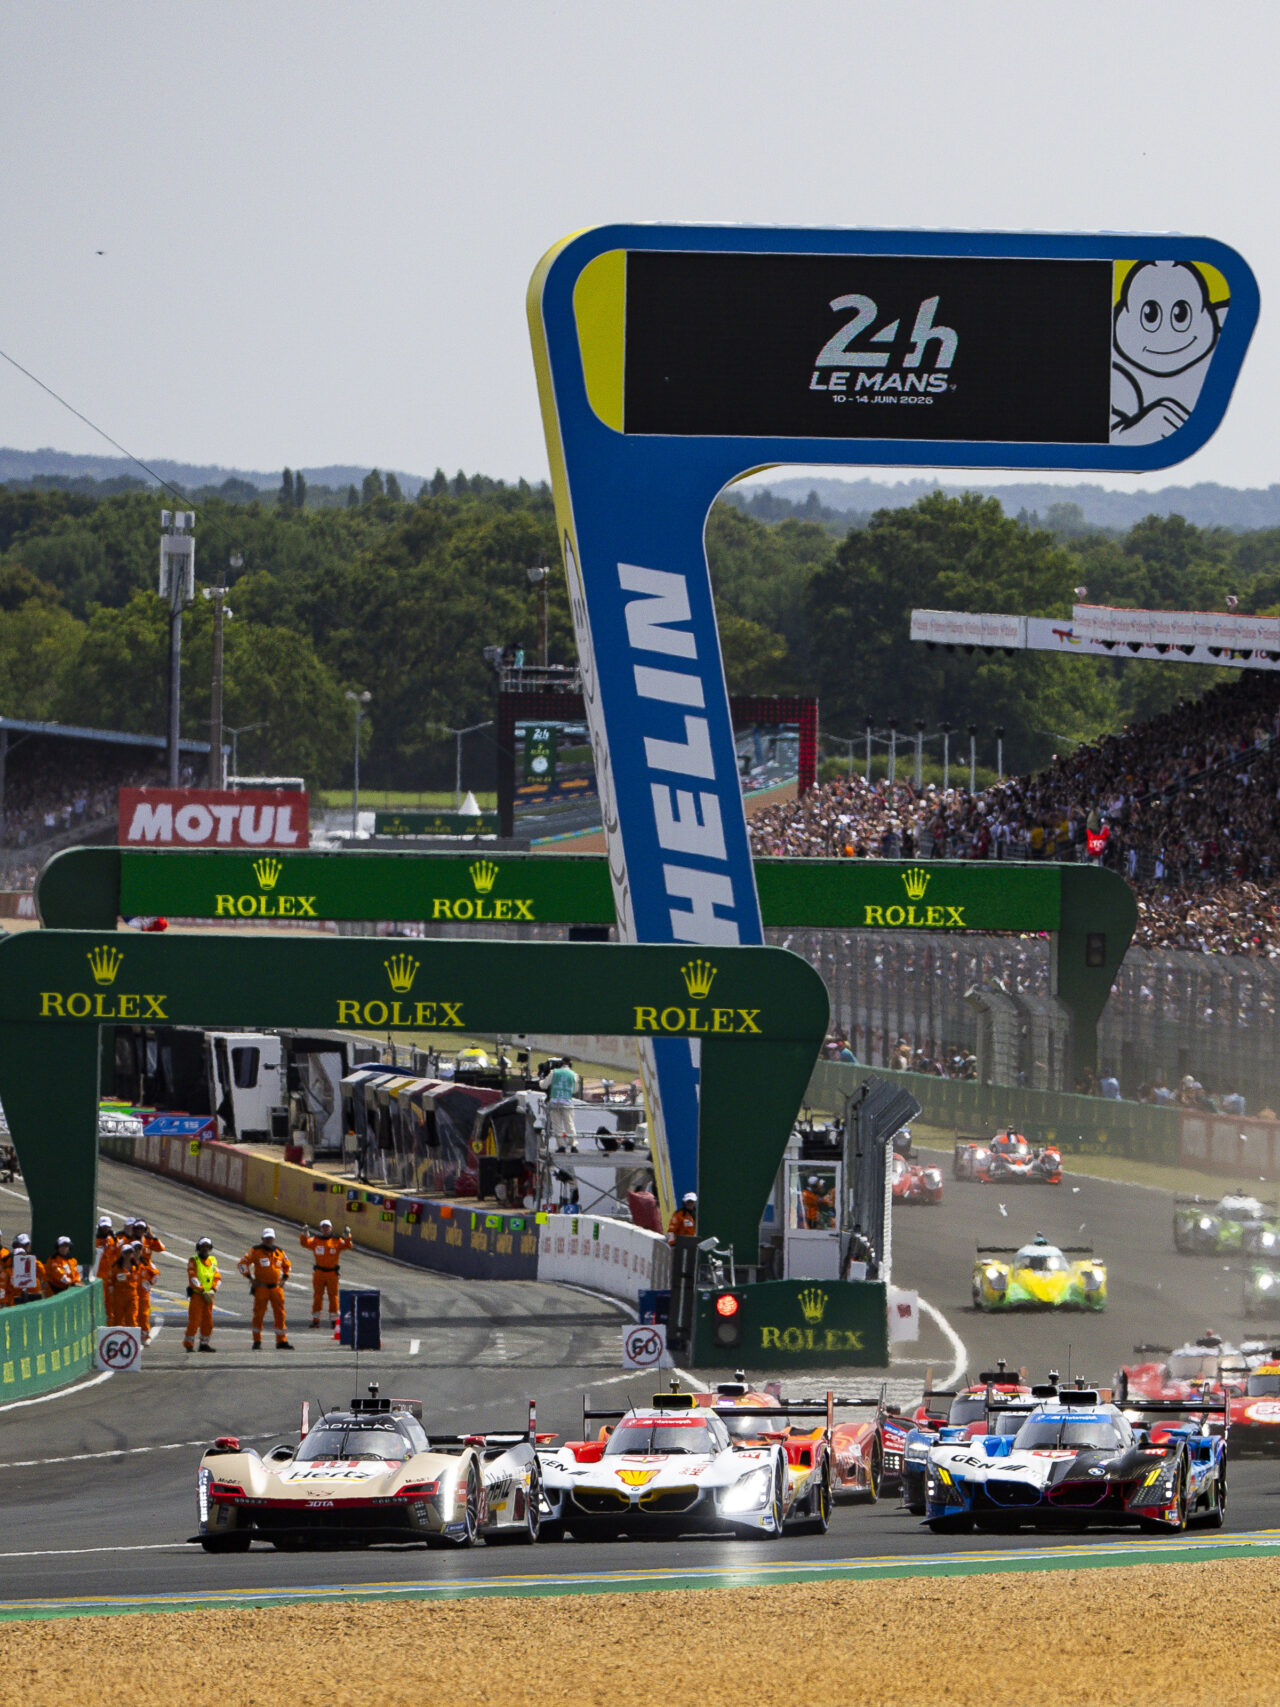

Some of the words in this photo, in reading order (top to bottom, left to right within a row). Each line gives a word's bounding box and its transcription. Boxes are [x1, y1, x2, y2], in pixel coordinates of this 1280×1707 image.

[815, 293, 959, 369] 24h
[809, 371, 850, 391] LE
[854, 372, 949, 393] MANS
[832, 395, 846, 403] 10
[856, 395, 868, 403] 14
[870, 395, 897, 404] JUIN
[617, 562, 741, 945] HELIN
[127, 803, 299, 844] MOTUL
[215, 894, 318, 917] ROLEX
[432, 898, 535, 921] ROLEX
[864, 904, 966, 927] ROLEX
[40, 992, 169, 1019] ROLEX
[336, 1000, 465, 1027] ROLEX
[633, 1006, 762, 1034] ROLEX
[760, 1326, 864, 1350] ROLEX
[315, 1423, 396, 1431] CADILLAC
[951, 1454, 995, 1470] GEN
[290, 1471, 371, 1480] Hertz
